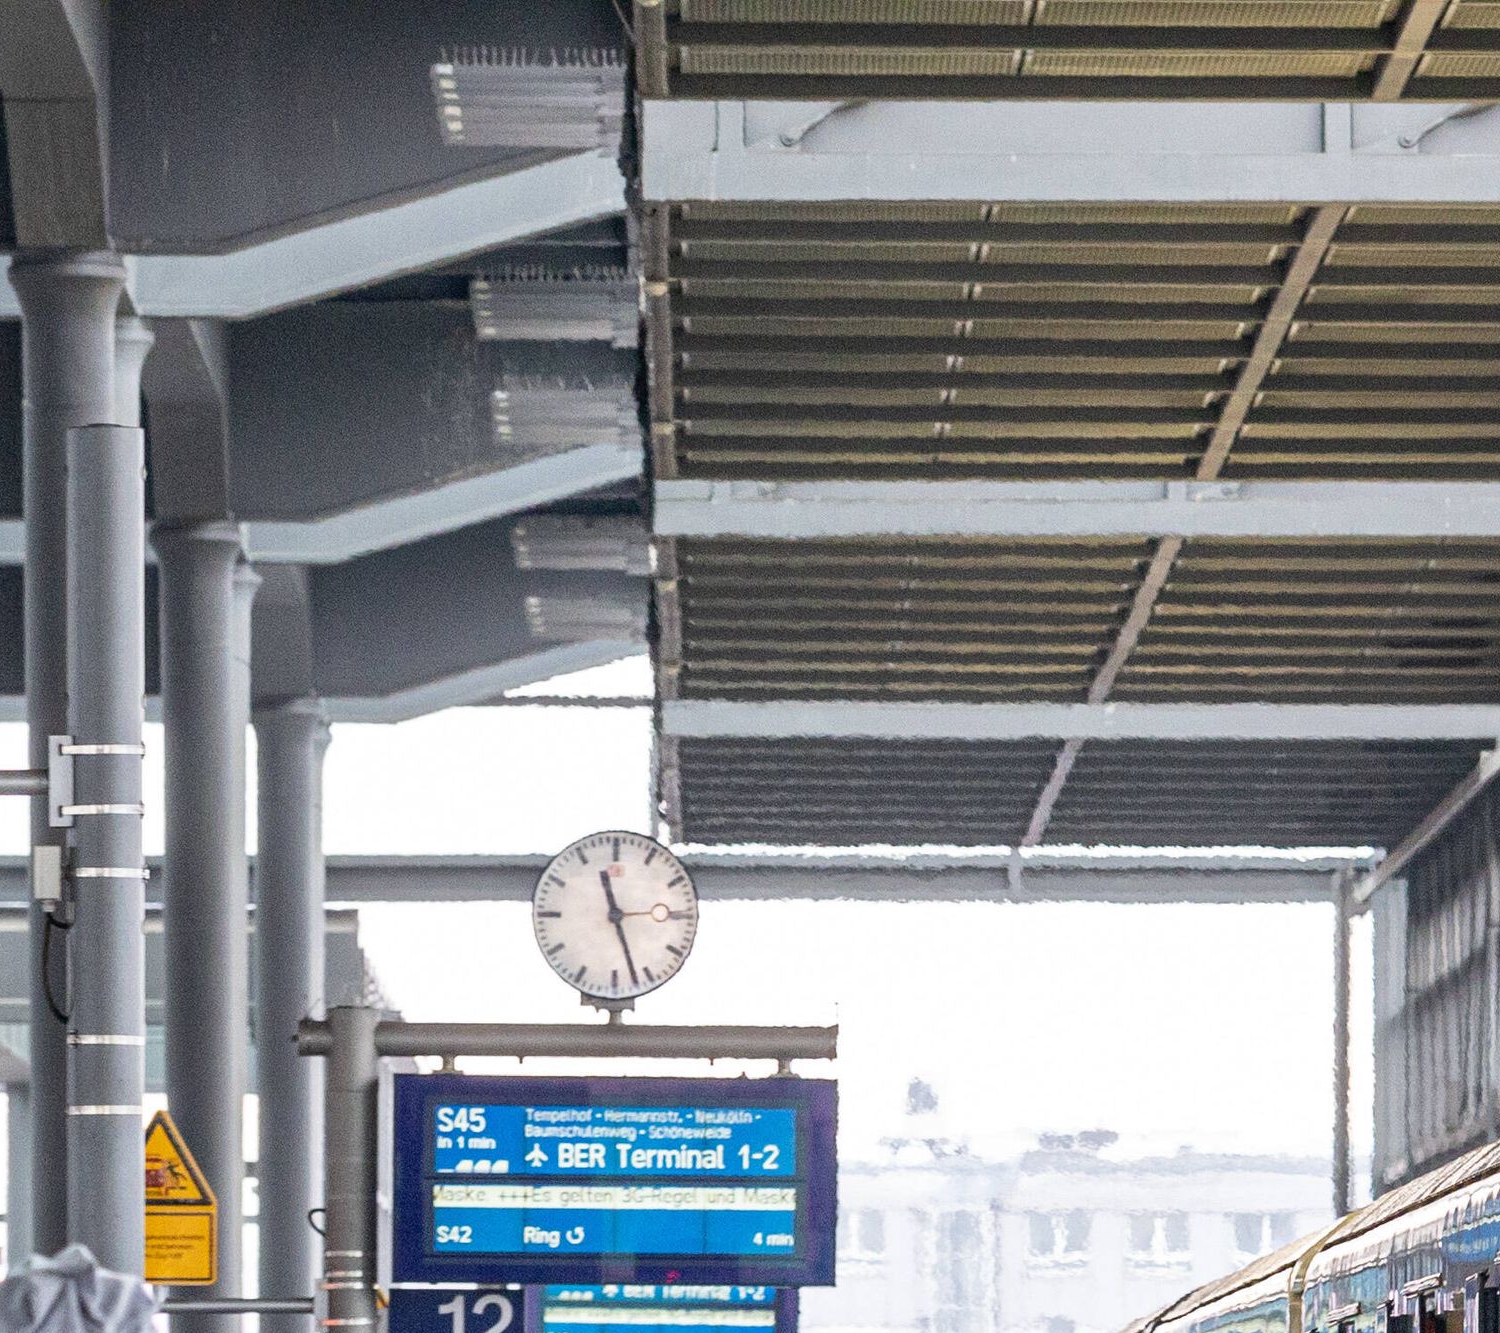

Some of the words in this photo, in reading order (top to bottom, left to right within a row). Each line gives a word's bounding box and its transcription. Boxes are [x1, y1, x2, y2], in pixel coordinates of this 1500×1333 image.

[437, 1106, 487, 1133] S45
[525, 1108, 593, 1124] Tempelhof
[604, 1109, 683, 1123] Hermannstr.
[695, 1109, 753, 1124] Neukölln
[436, 1136, 453, 1149] in
[457, 1136, 465, 1149] 1
[467, 1136, 497, 1149] min
[524, 1124, 636, 1141] Baumschulenweg
[649, 1125, 732, 1139] Schöneweide
[557, 1143, 606, 1168] BER
[615, 1143, 726, 1169] Terminal
[737, 1143, 781, 1170] 1-2
[559, 1187, 613, 1207] gelten
[622, 1187, 696, 1208] 3G-Regel
[706, 1188, 736, 1204] und
[436, 1225, 473, 1243] S42
[523, 1226, 561, 1248] Ring
[752, 1232, 763, 1246] 4
[765, 1234, 795, 1246] min
